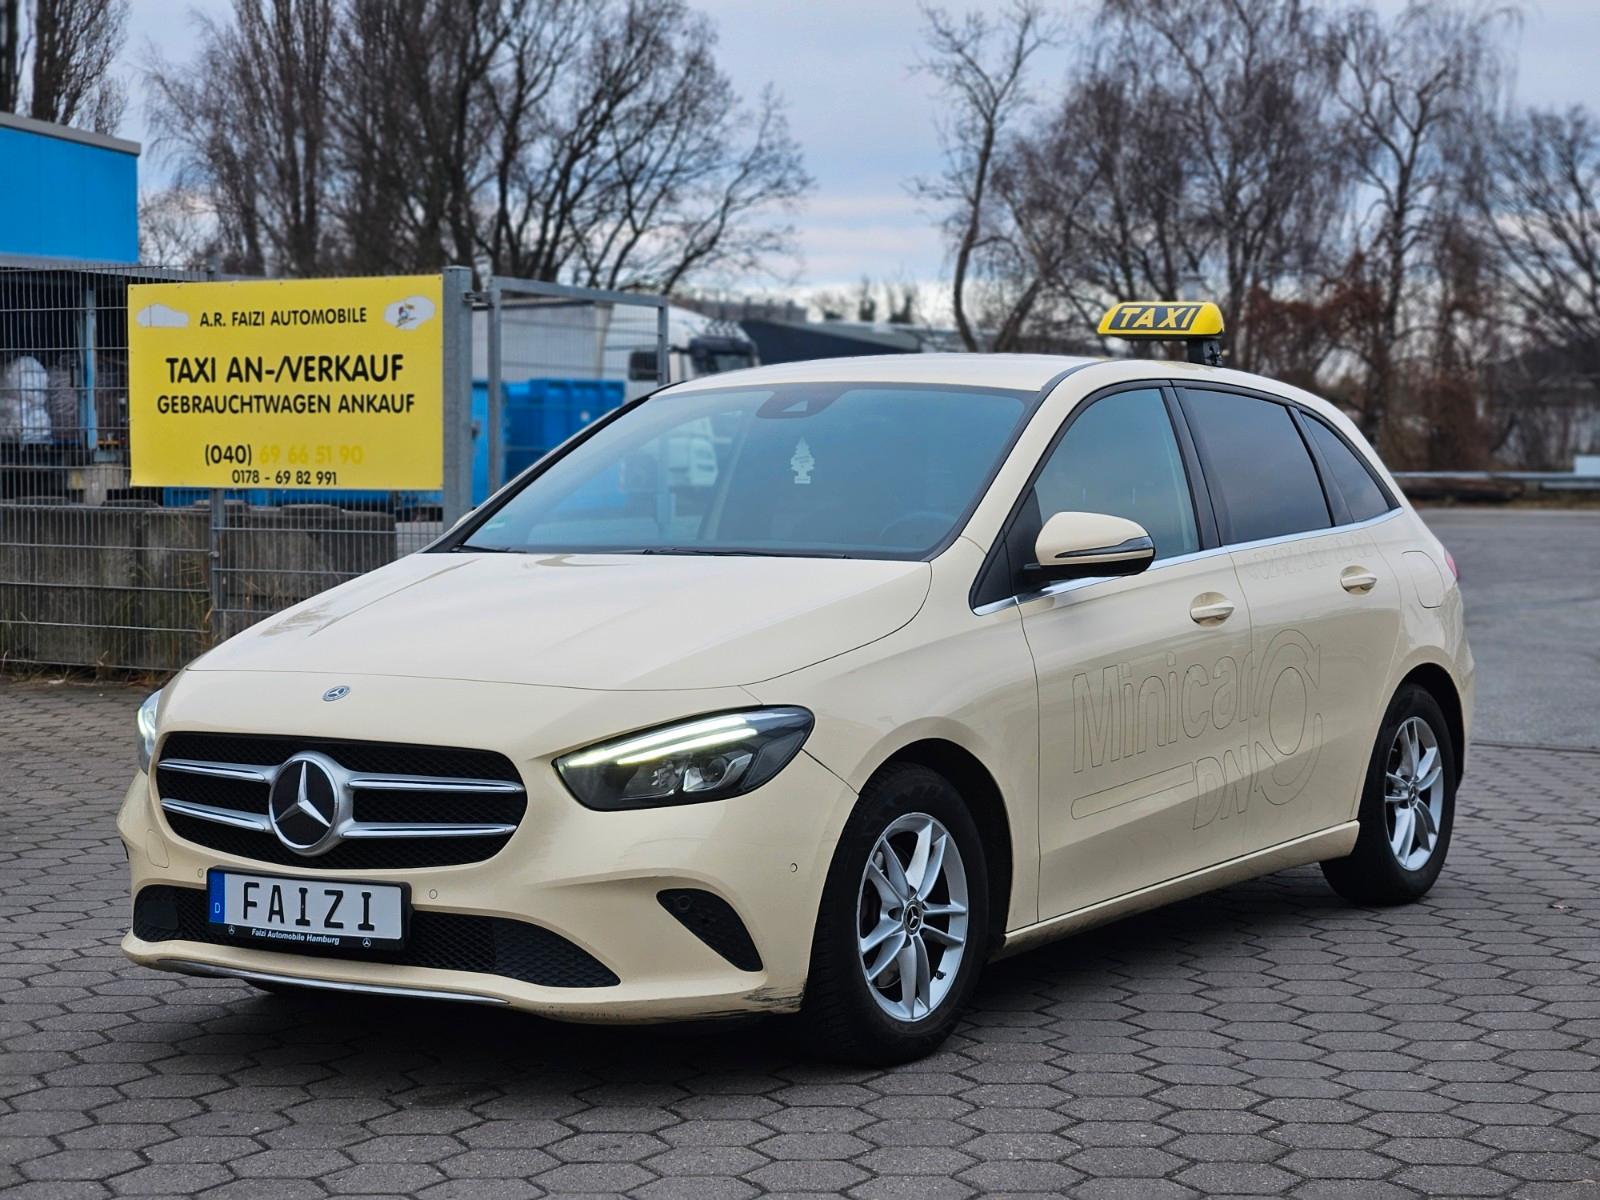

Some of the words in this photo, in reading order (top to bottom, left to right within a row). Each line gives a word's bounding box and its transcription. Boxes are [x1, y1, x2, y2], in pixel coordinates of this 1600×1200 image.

[200, 311, 226, 327] A.R.
[231, 310, 265, 326] FAIZI
[270, 307, 367, 326] AUTOMOBILE
[1120, 307, 1196, 328] TAXI
[166, 357, 216, 383] TAXI
[226, 354, 404, 383] AN-/VERKAUF
[157, 394, 331, 414] GEBRAUCHTWAGEN
[338, 394, 415, 413] ANKAUF
[205, 445, 252, 466] (040)
[259, 446, 280, 465] 69
[287, 446, 309, 465] 66
[315, 445, 334, 464] 51
[340, 445, 364, 464] 90
[232, 470, 260, 484] 0178
[275, 471, 291, 485] 69
[296, 470, 311, 485] 82
[316, 470, 337, 485] 991
[1072, 650, 1257, 774] Minicar
[213, 903, 221, 914] D
[243, 881, 375, 931] FAIZI
[251, 928, 267, 937] Faizi
[267, 930, 305, 942] Automobile
[306, 934, 340, 946] Hamburg
